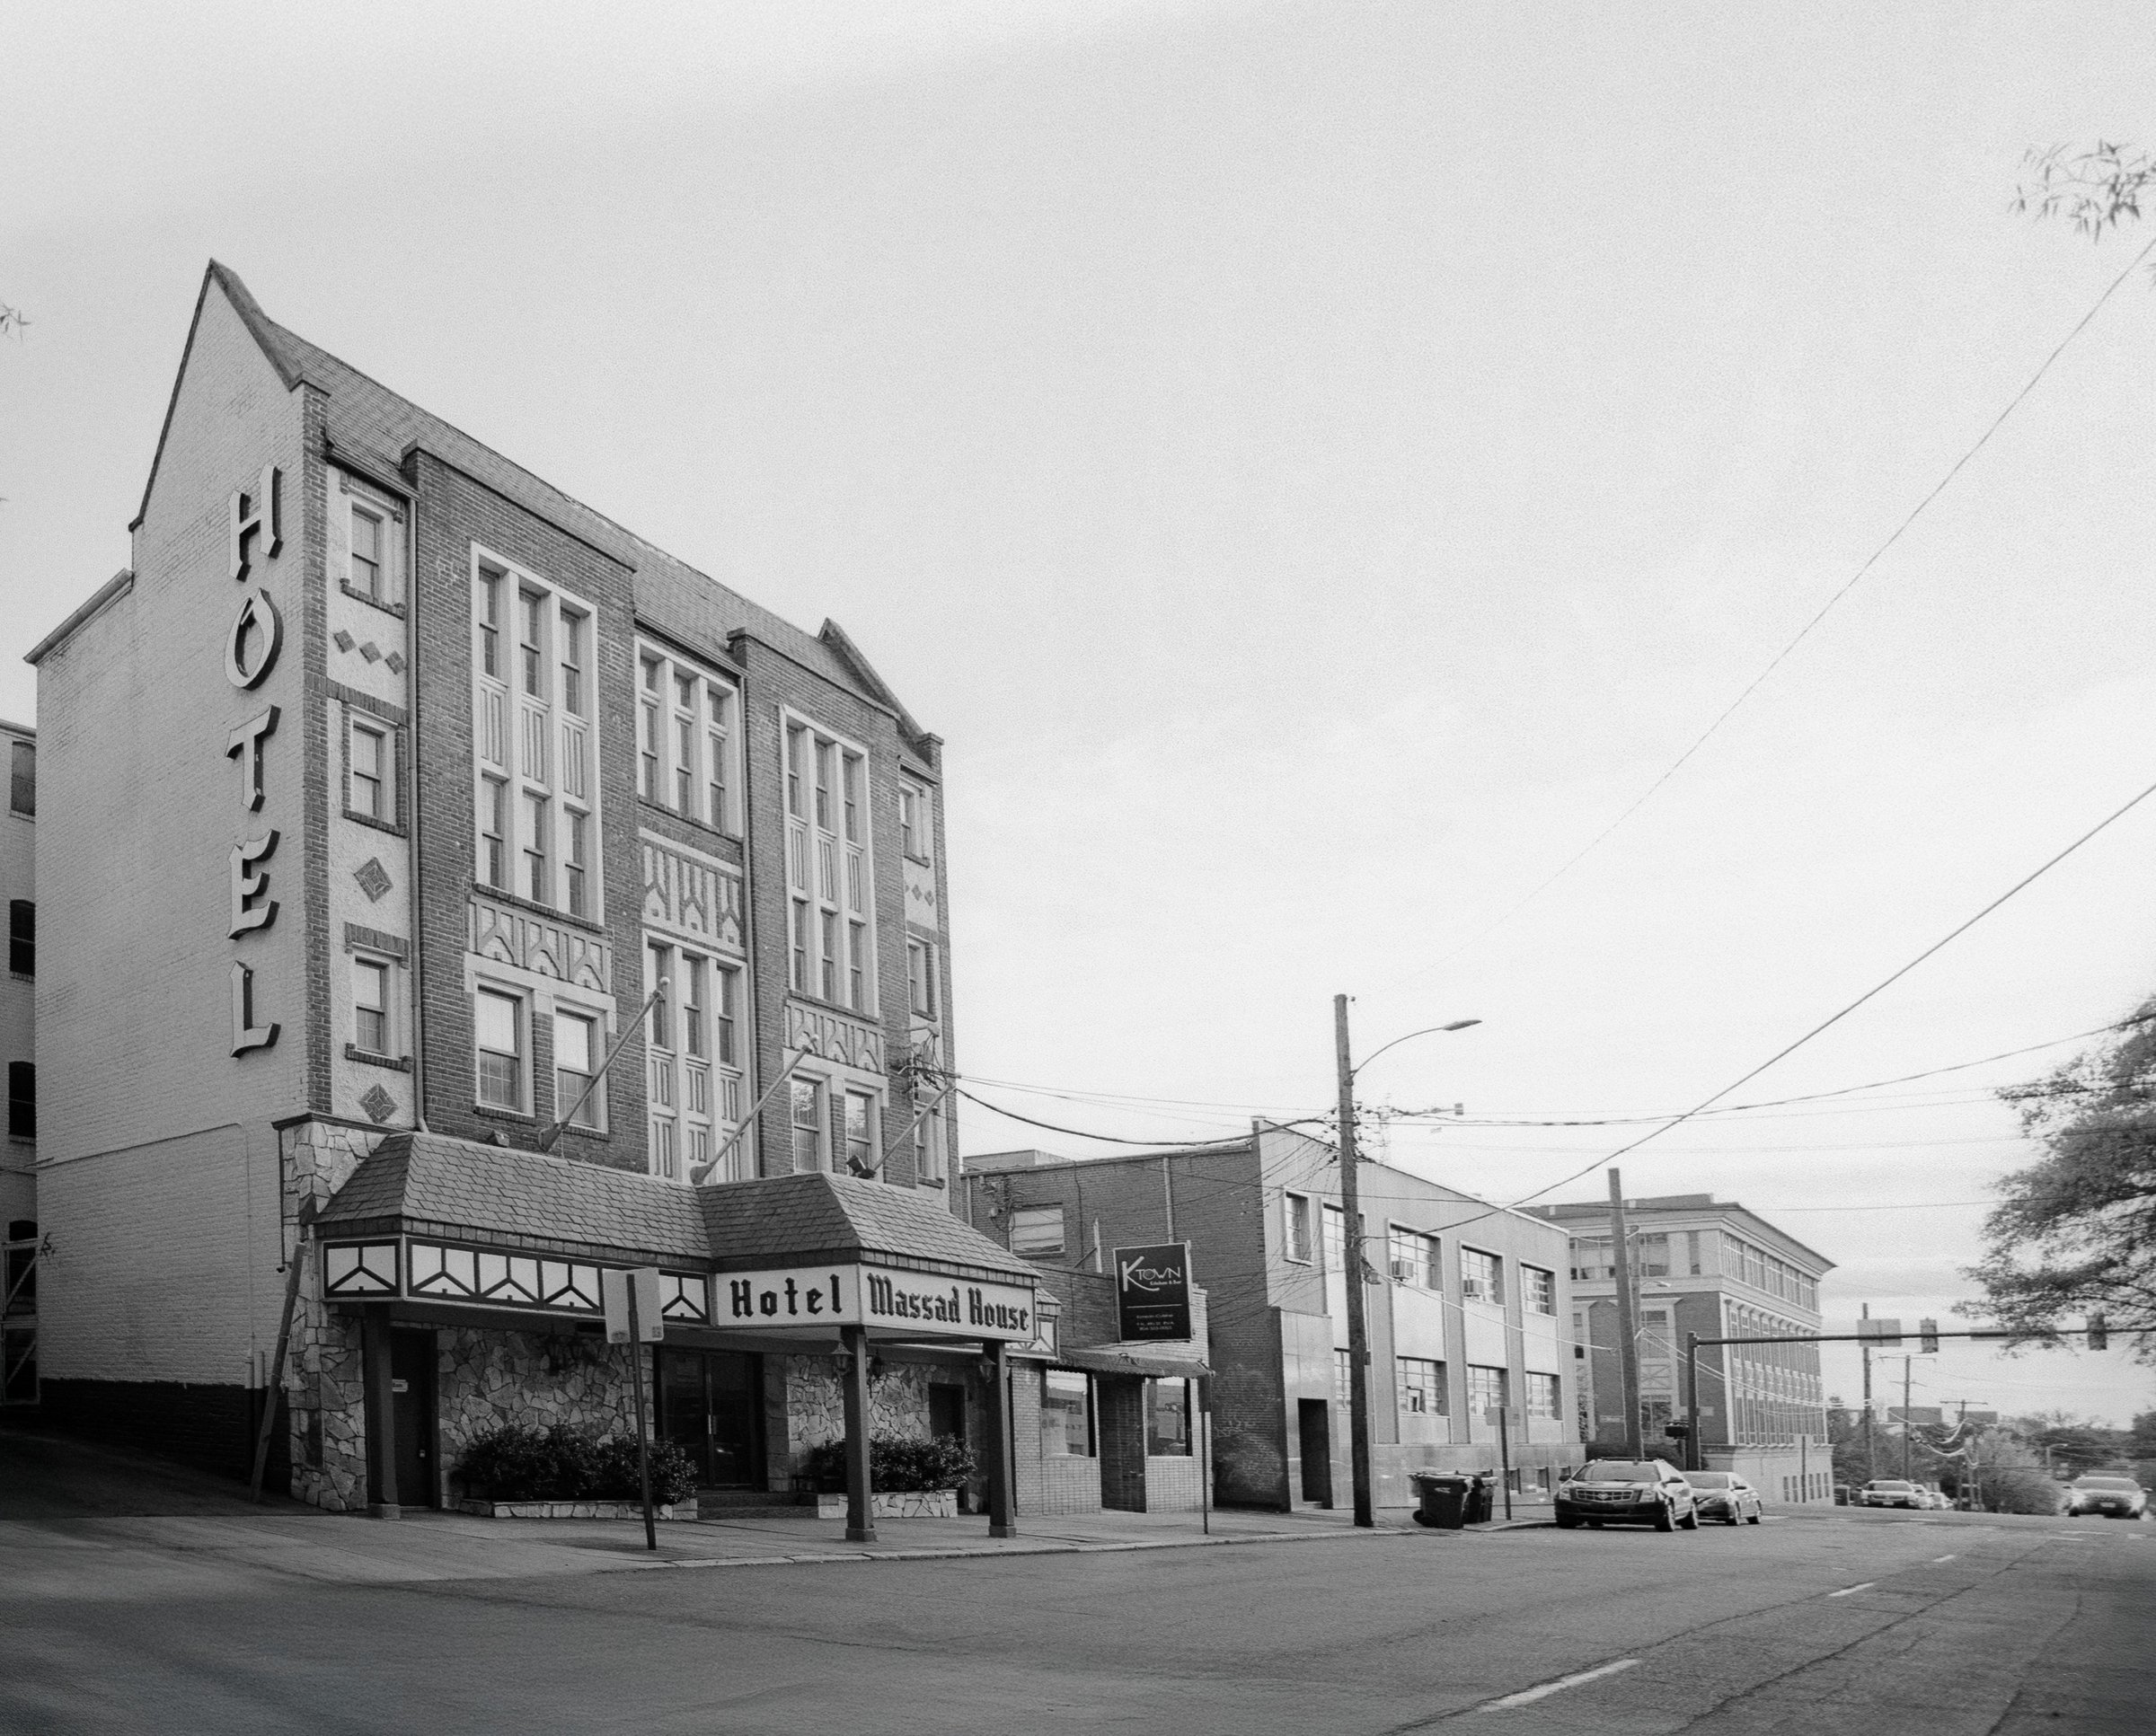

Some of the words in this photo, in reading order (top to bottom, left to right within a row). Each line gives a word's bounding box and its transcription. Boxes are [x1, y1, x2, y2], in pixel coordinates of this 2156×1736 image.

[225, 464, 282, 1058] HOTEL
[729, 1273, 843, 1318] Hotel
[867, 1272, 961, 1324] Massad
[968, 1286, 1029, 1331] House
